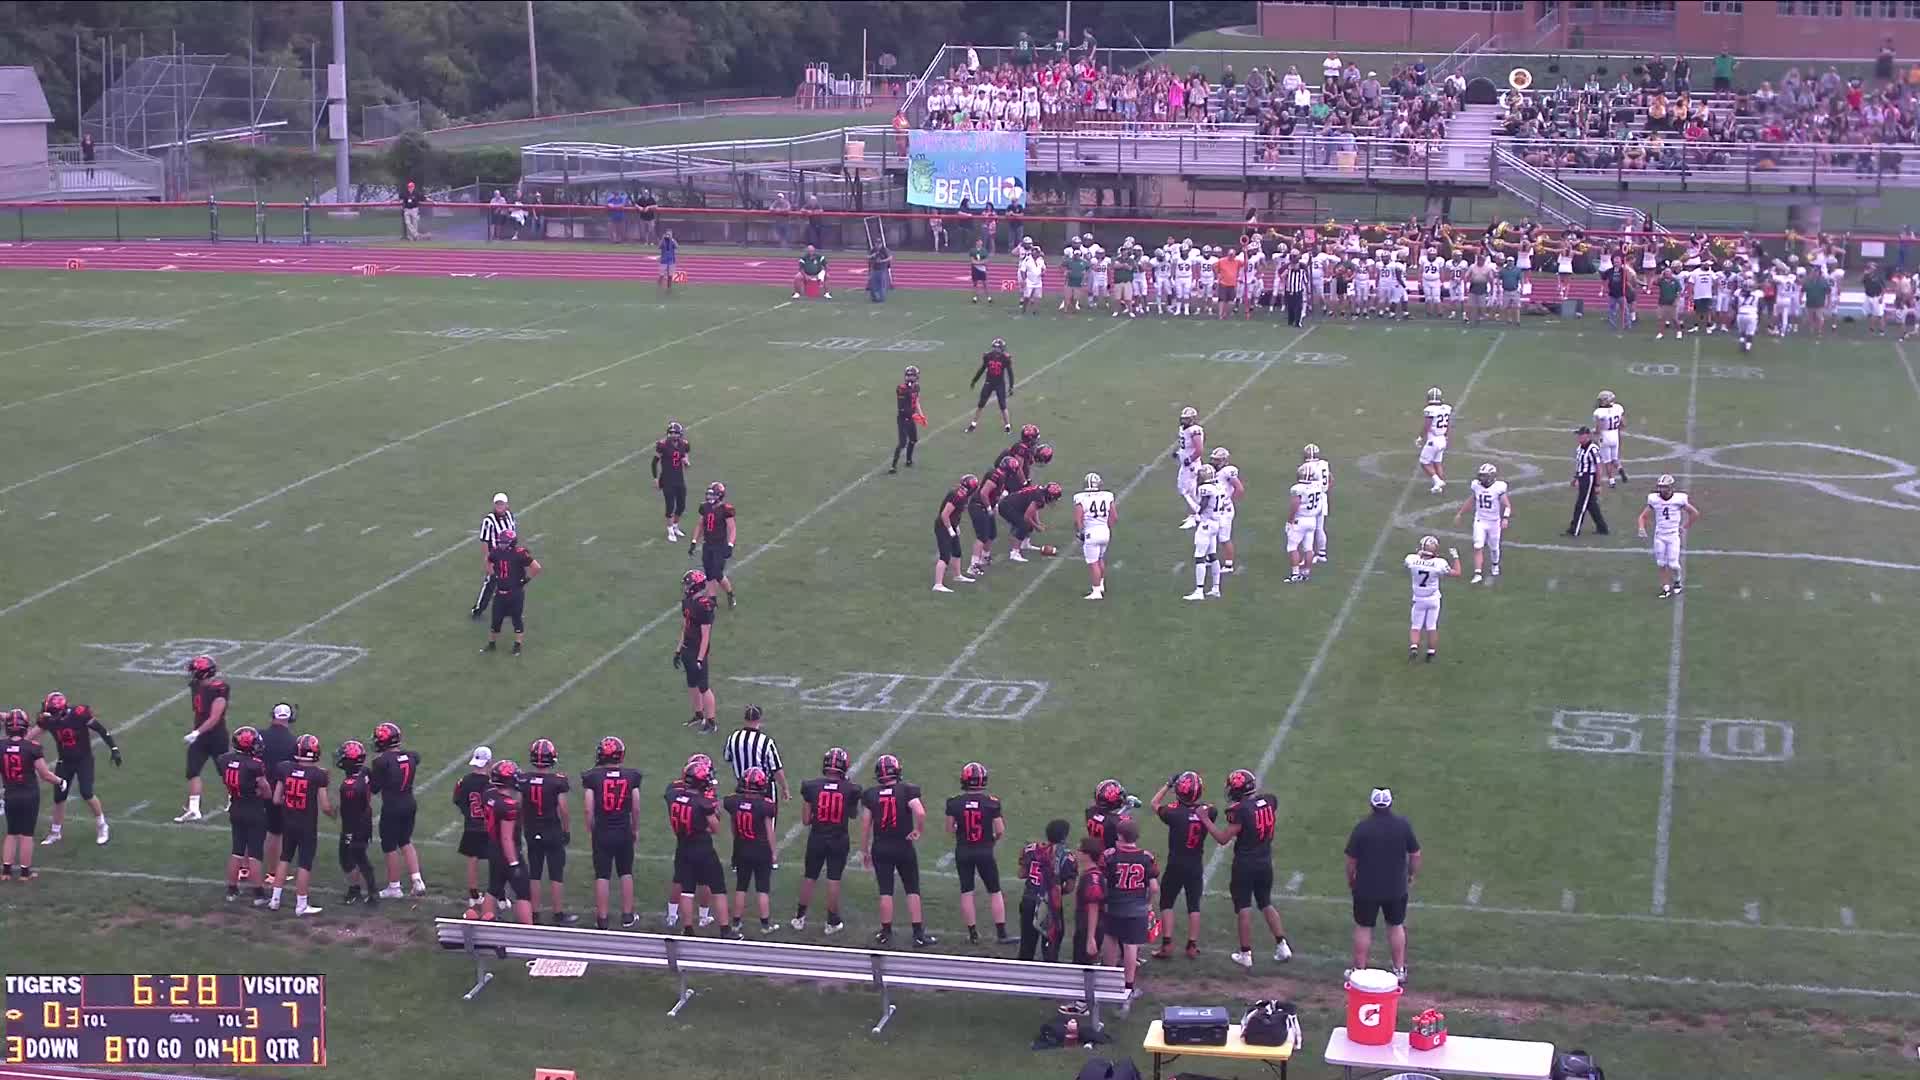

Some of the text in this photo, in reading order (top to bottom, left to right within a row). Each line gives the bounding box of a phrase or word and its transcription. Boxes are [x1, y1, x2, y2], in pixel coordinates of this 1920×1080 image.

[934, 176, 1002, 205] BEACH
[1436, 413, 1449, 428] 23
[1607, 415, 1620, 430] 12
[1089, 500, 1107, 518] 44
[1306, 492, 1320, 510] 35
[1478, 494, 1492, 509] 15
[1662, 507, 1670, 520] 4
[1418, 570, 1430, 587] 7
[799, 672, 1048, 720] 40
[1548, 709, 1794, 761] 50
[400, 763, 411, 792] 7
[285, 777, 308, 809] 25
[531, 786, 543, 816] 4
[602, 779, 628, 811] 67
[817, 791, 843, 823] 80
[671, 802, 692, 834] 64
[736, 810, 756, 839] 10
[879, 796, 897, 829] 71
[963, 811, 982, 841] 15
[1254, 805, 1276, 841] 44
[1114, 863, 1146, 889] 72
[1358, 1003, 1381, 1027] G
